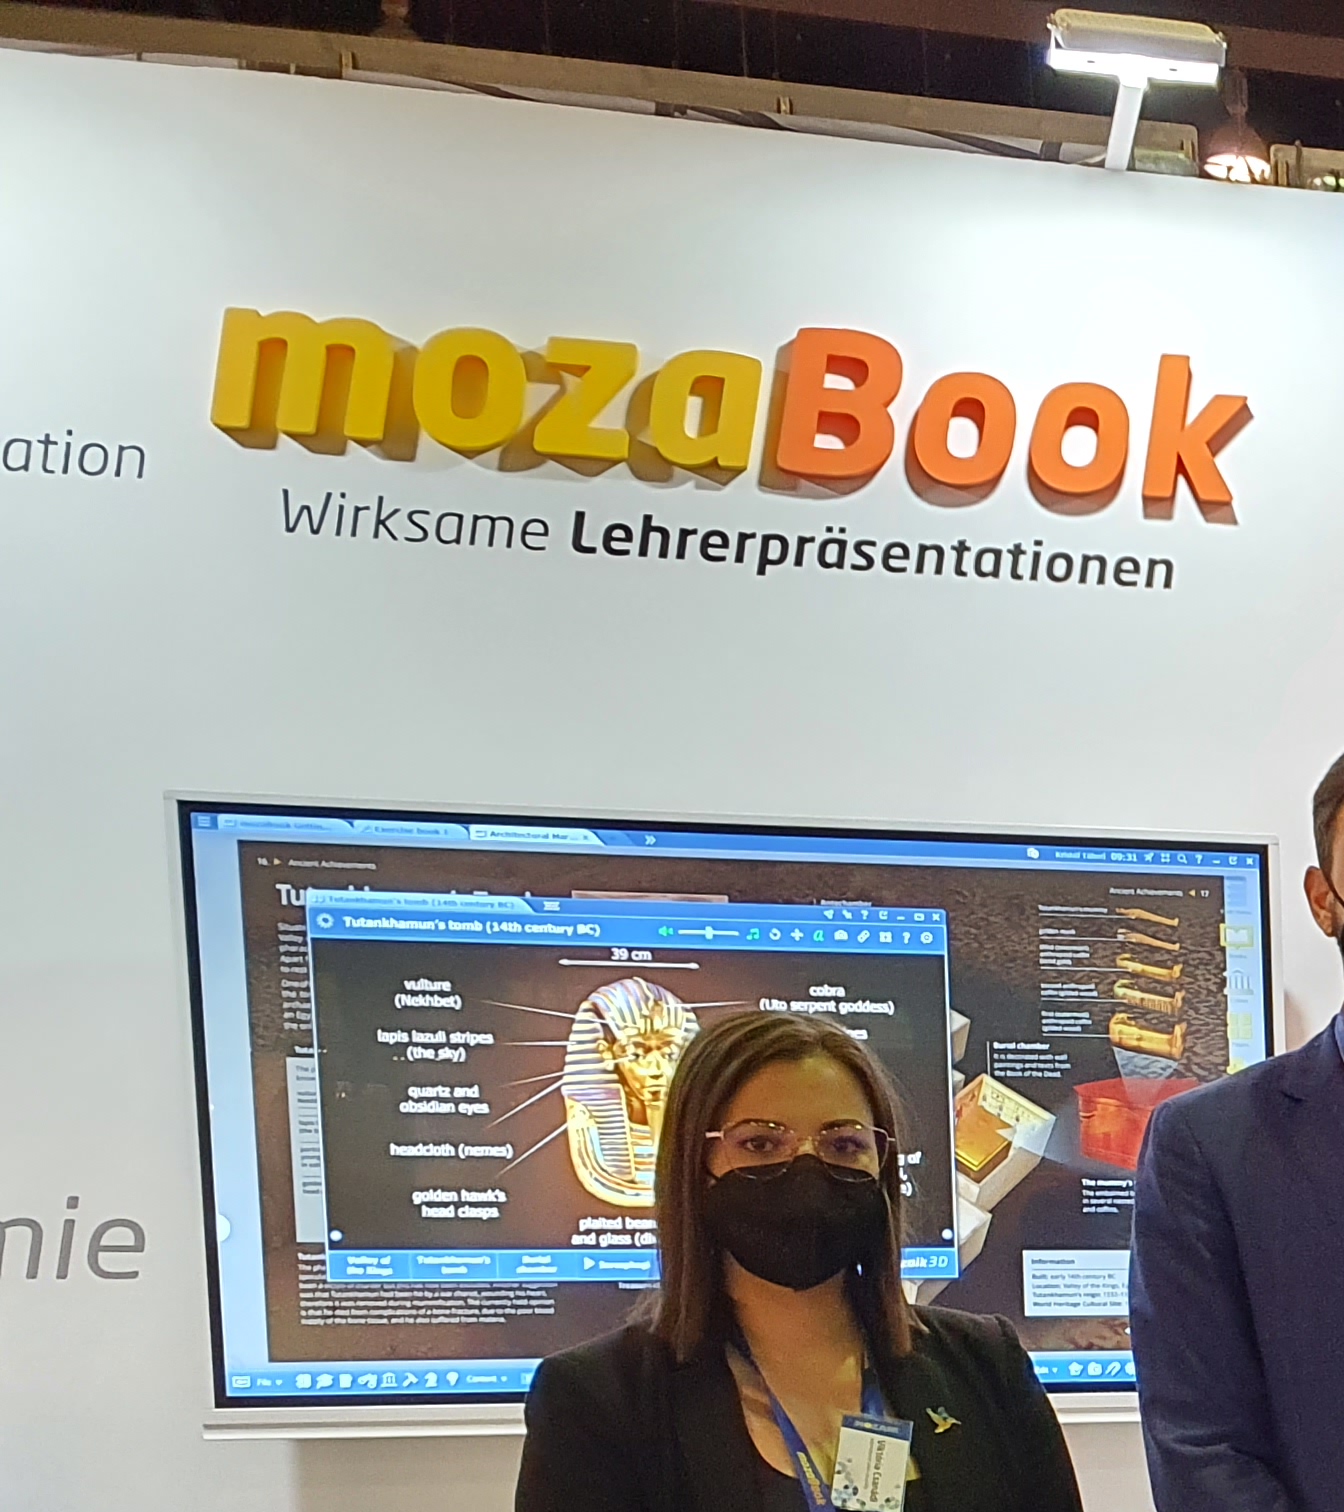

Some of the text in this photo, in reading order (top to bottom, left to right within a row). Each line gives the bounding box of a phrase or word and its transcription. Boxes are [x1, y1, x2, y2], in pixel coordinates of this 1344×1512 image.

[211, 306, 1254, 522] mozaBook
[2, 429, 145, 479] ation
[279, 488, 1176, 590] Wirksame Lehrerpräsentationen
[1110, 852, 1138, 862] 09:31
[343, 916, 446, 932] Tutankhamun's
[448, 919, 483, 933] tomb
[525, 922, 574, 937] century
[611, 948, 653, 961] 39 cm
[403, 978, 452, 992] vulture
[808, 983, 846, 998] cobra
[394, 993, 463, 1011] (Nekhbet)
[758, 997, 896, 1016] (Uto serpent goddess)
[376, 1028, 495, 1046] lapis lazuli stripes
[406, 1045, 467, 1063] (the sky)
[407, 1084, 480, 1100] quartz and
[399, 1100, 490, 1115] obsidian eyes
[389, 1142, 514, 1160] headcloth (nemes)
[412, 1188, 507, 1205] golden hawk's
[421, 1205, 500, 1220] head clasps
[578, 1217, 622, 1231] plaited
[571, 1232, 597, 1245] and
[598, 1234, 632, 1247] glass
